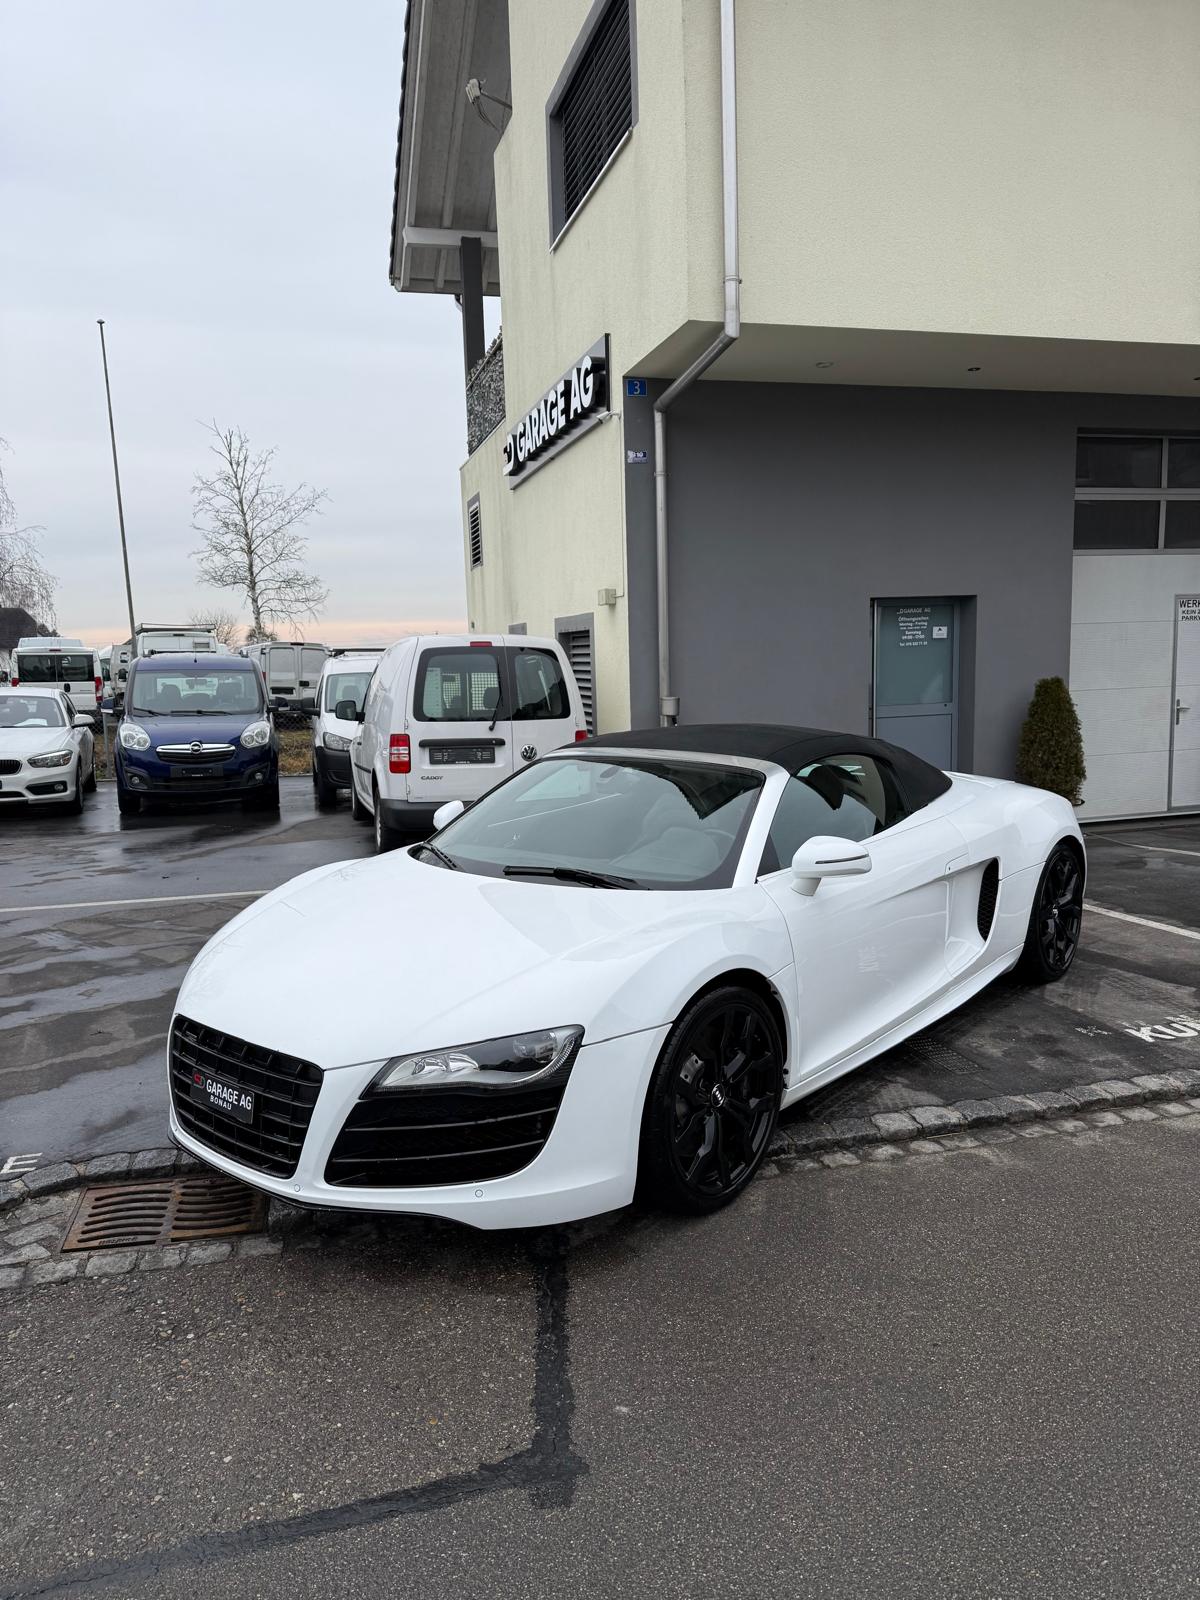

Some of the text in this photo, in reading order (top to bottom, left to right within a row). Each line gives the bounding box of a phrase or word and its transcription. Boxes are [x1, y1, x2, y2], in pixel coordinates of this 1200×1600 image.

[633, 381, 641, 395] 3
[516, 380, 566, 462] GARAGE
[570, 355, 594, 420] AG
[206, 1079, 239, 1105] GARAGE
[240, 1094, 252, 1110] AG
